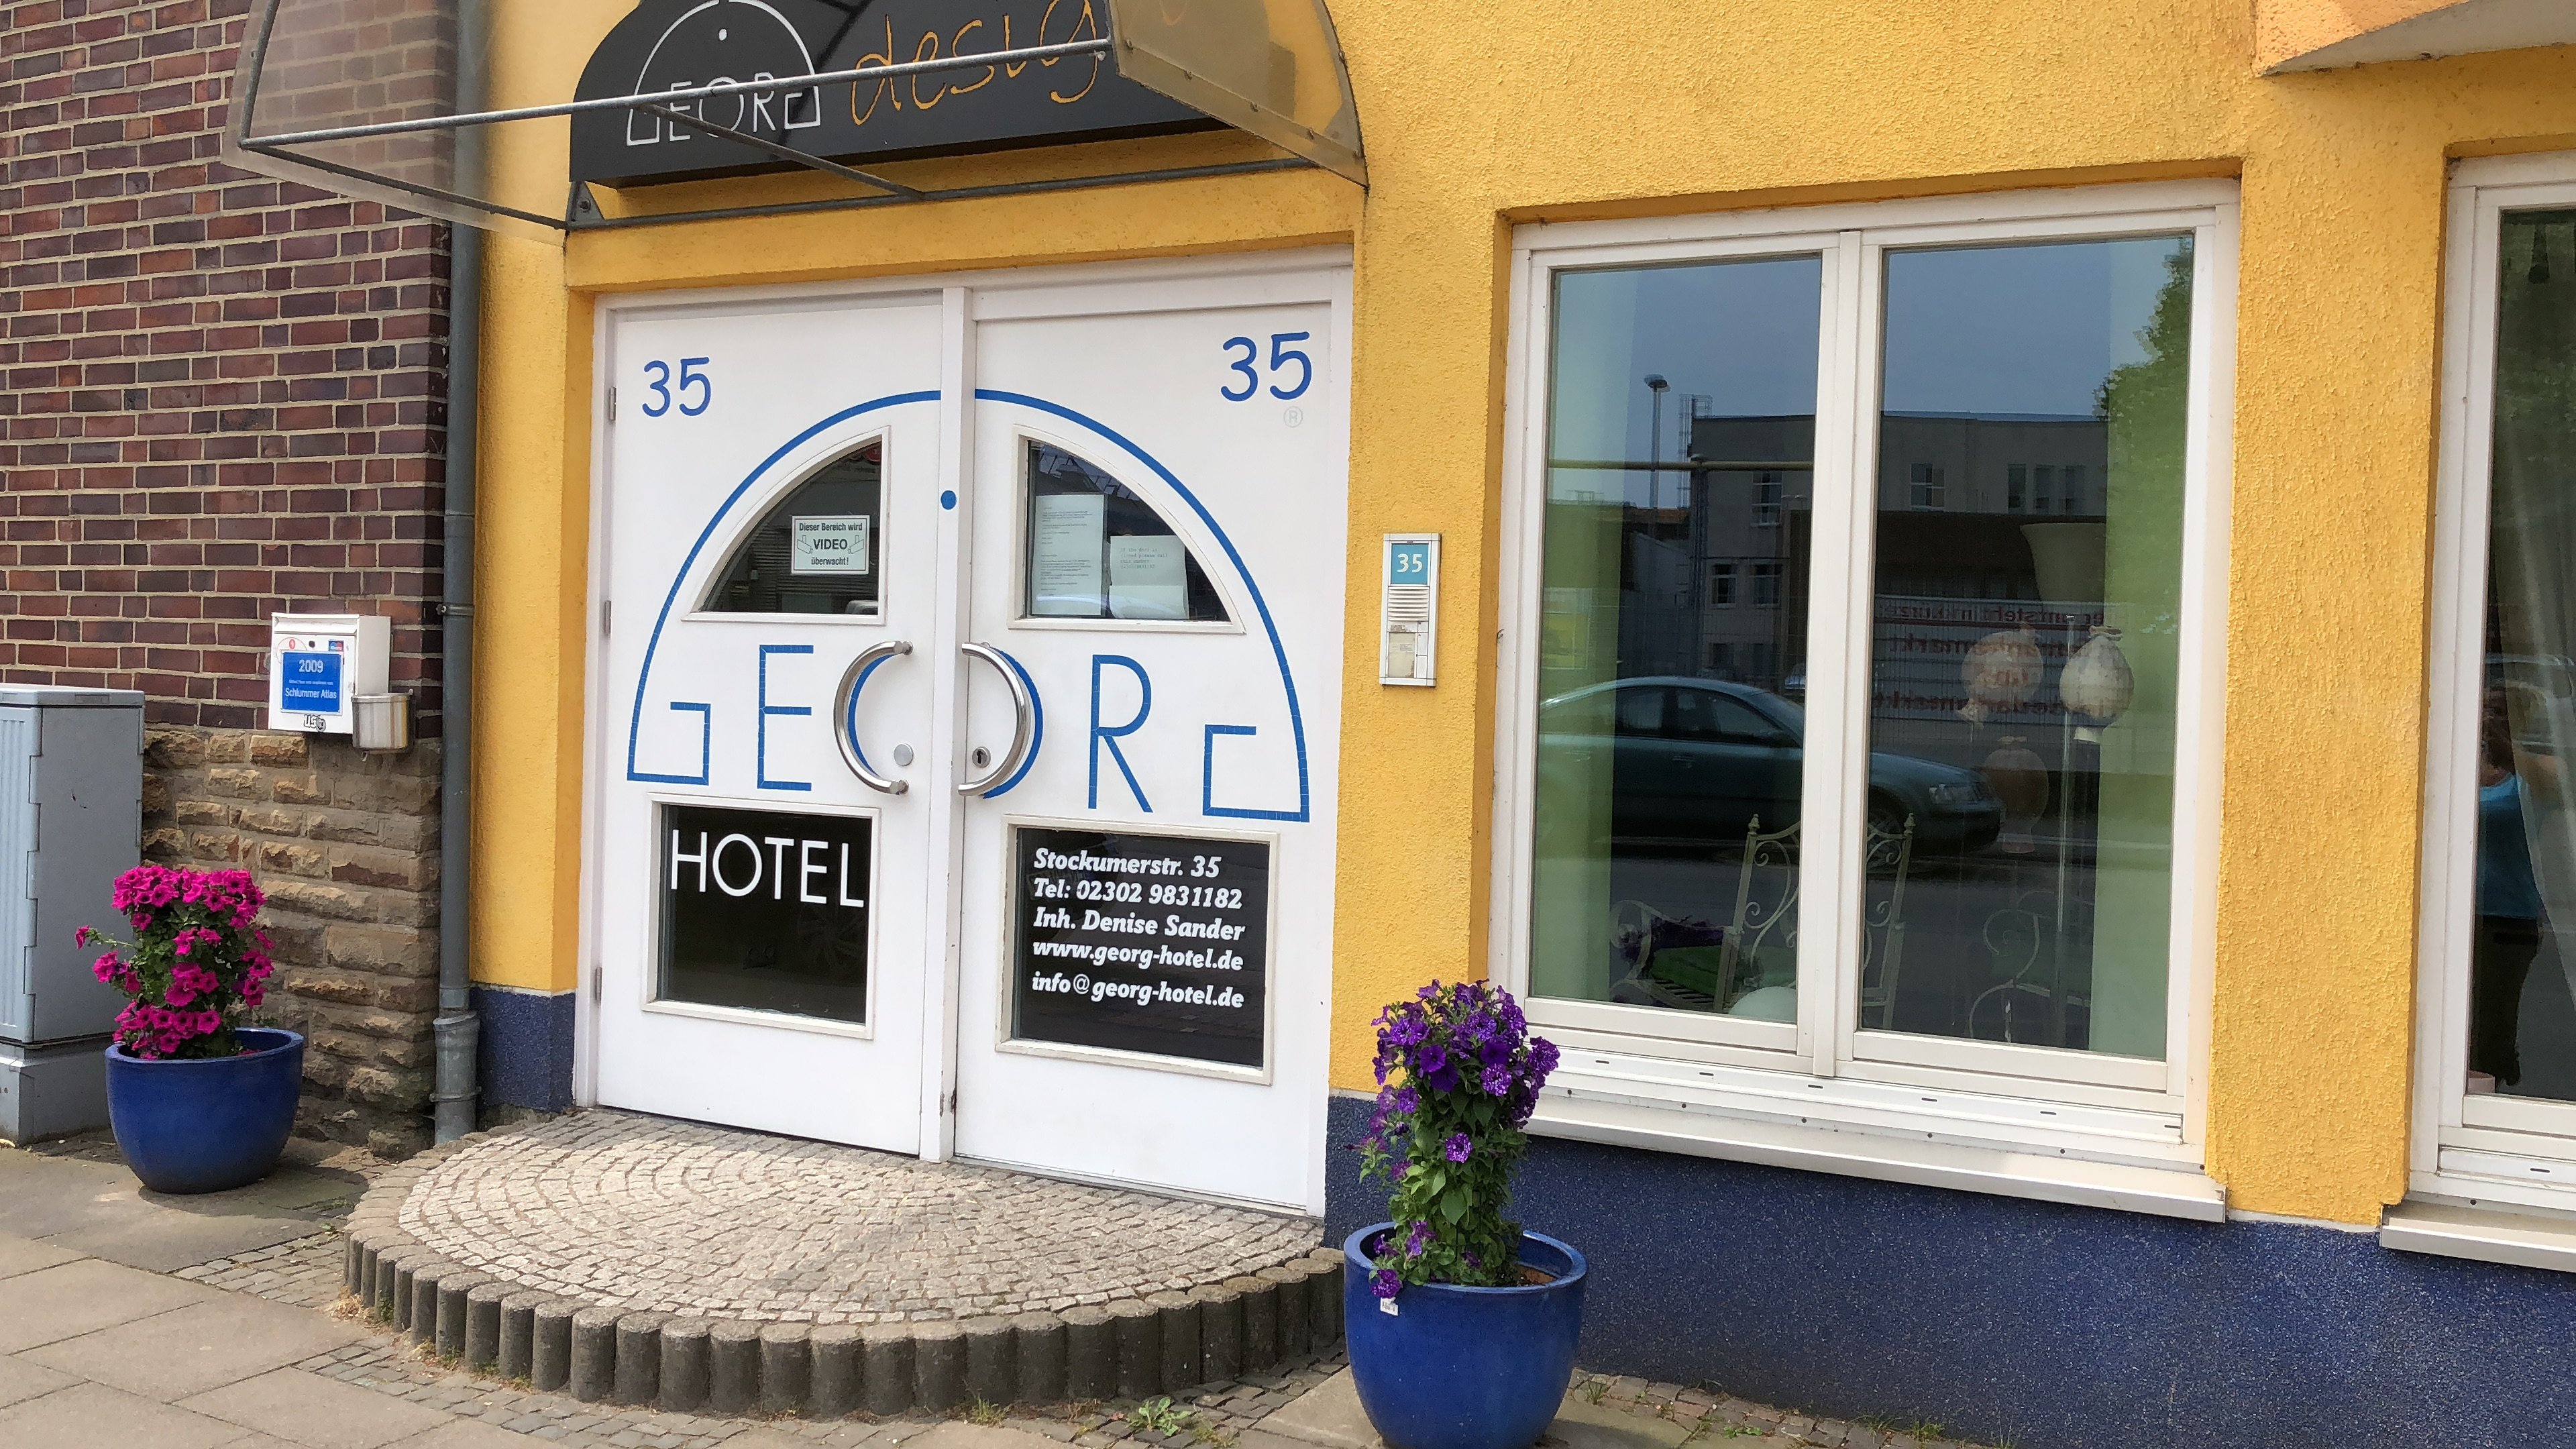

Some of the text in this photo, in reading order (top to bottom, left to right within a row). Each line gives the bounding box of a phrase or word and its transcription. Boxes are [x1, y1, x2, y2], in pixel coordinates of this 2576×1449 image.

[850, 0, 1104, 126] desig
[1220, 331, 1312, 402] 35
[642, 357, 712, 417] 35
[799, 523, 863, 531] Dieser Bereich wird
[812, 539, 848, 550] VIDEO
[811, 557, 849, 566] überwacht!
[1397, 553, 1424, 573] 35
[299, 659, 324, 674] 2009
[285, 687, 337, 699] Schlummer Atlas
[671, 828, 865, 908] HOTEL
[1034, 847, 1222, 877] Stockumerstr. 35
[1034, 878, 1243, 910] Tel: 02302 9831182
[1033, 906, 1246, 941] Inh. Denise Sander
[1033, 942, 1244, 971] www.georg-hotel.de
[1032, 971, 1244, 1008] info@georg-hotel.de
